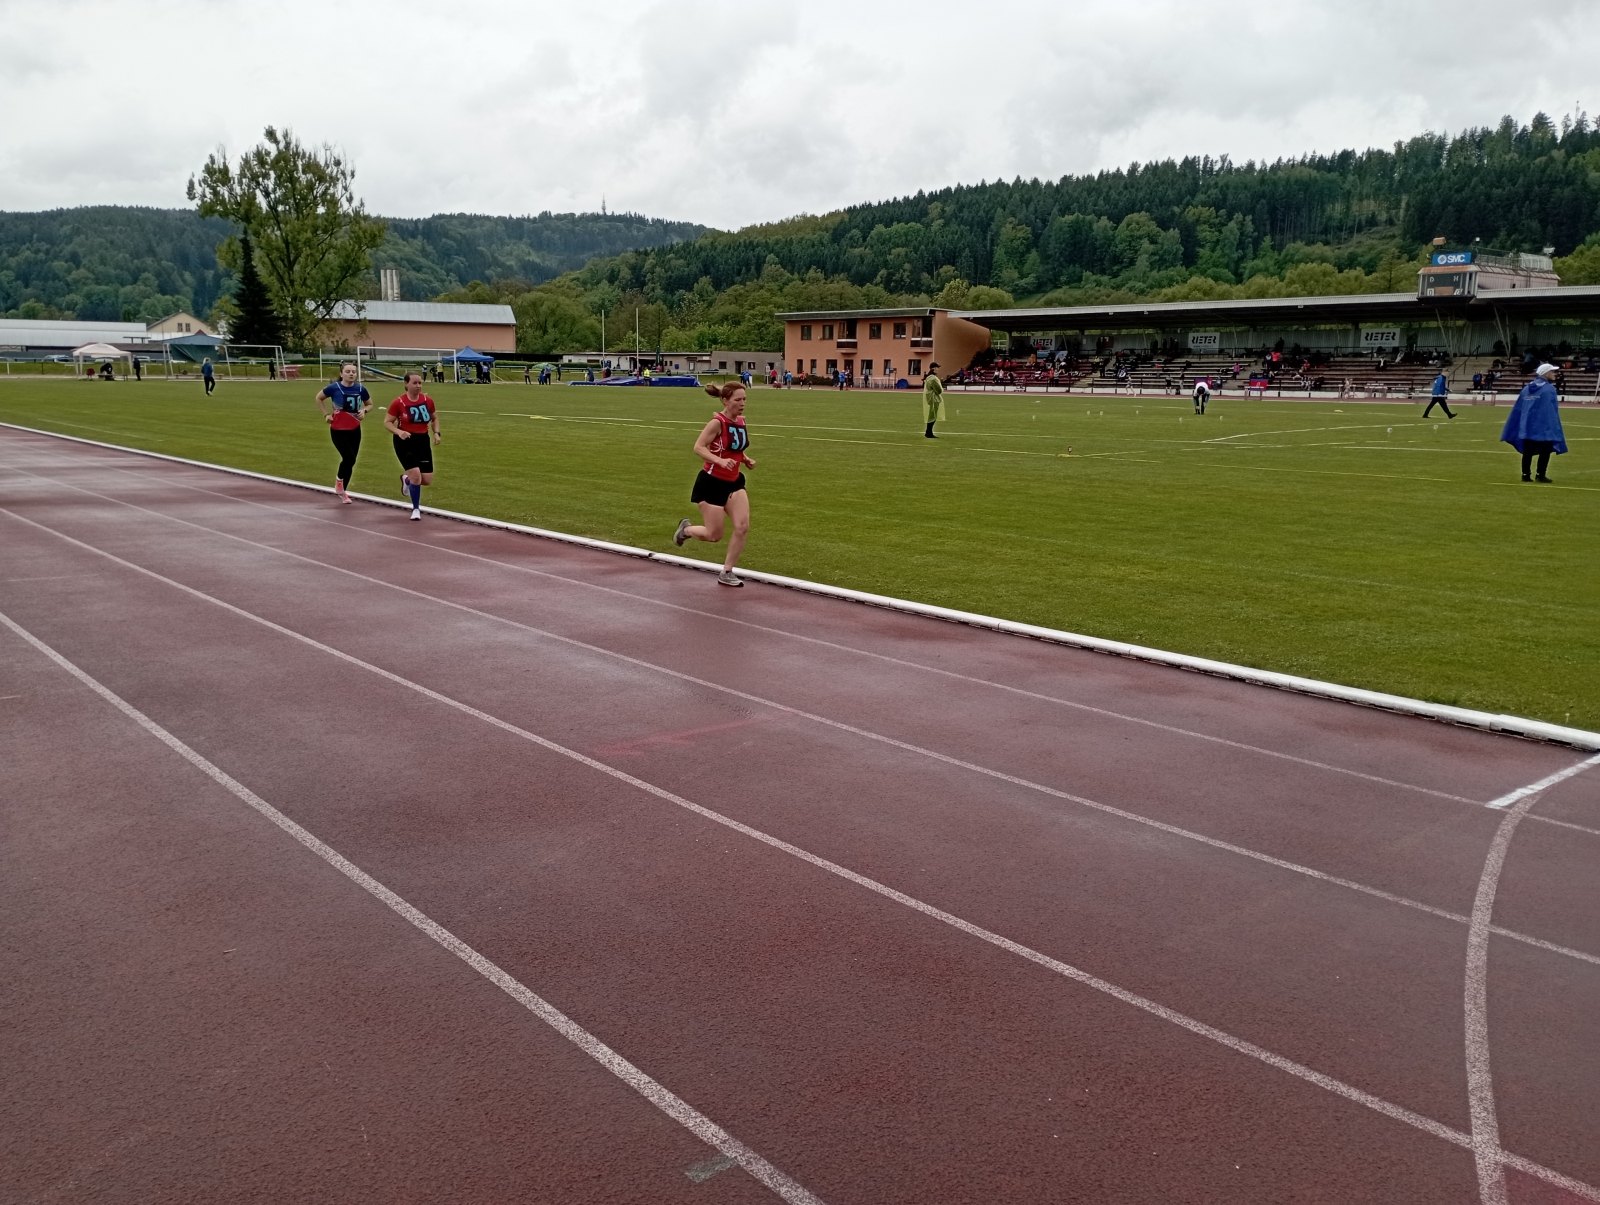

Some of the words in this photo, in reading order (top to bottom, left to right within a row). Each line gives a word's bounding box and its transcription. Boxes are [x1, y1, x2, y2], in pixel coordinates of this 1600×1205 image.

[1447, 254, 1465, 263] SMC
[1191, 335, 1217, 344] RIETER
[1364, 331, 1396, 341] RIETER
[410, 404, 431, 423] 28
[728, 426, 747, 450] 37
